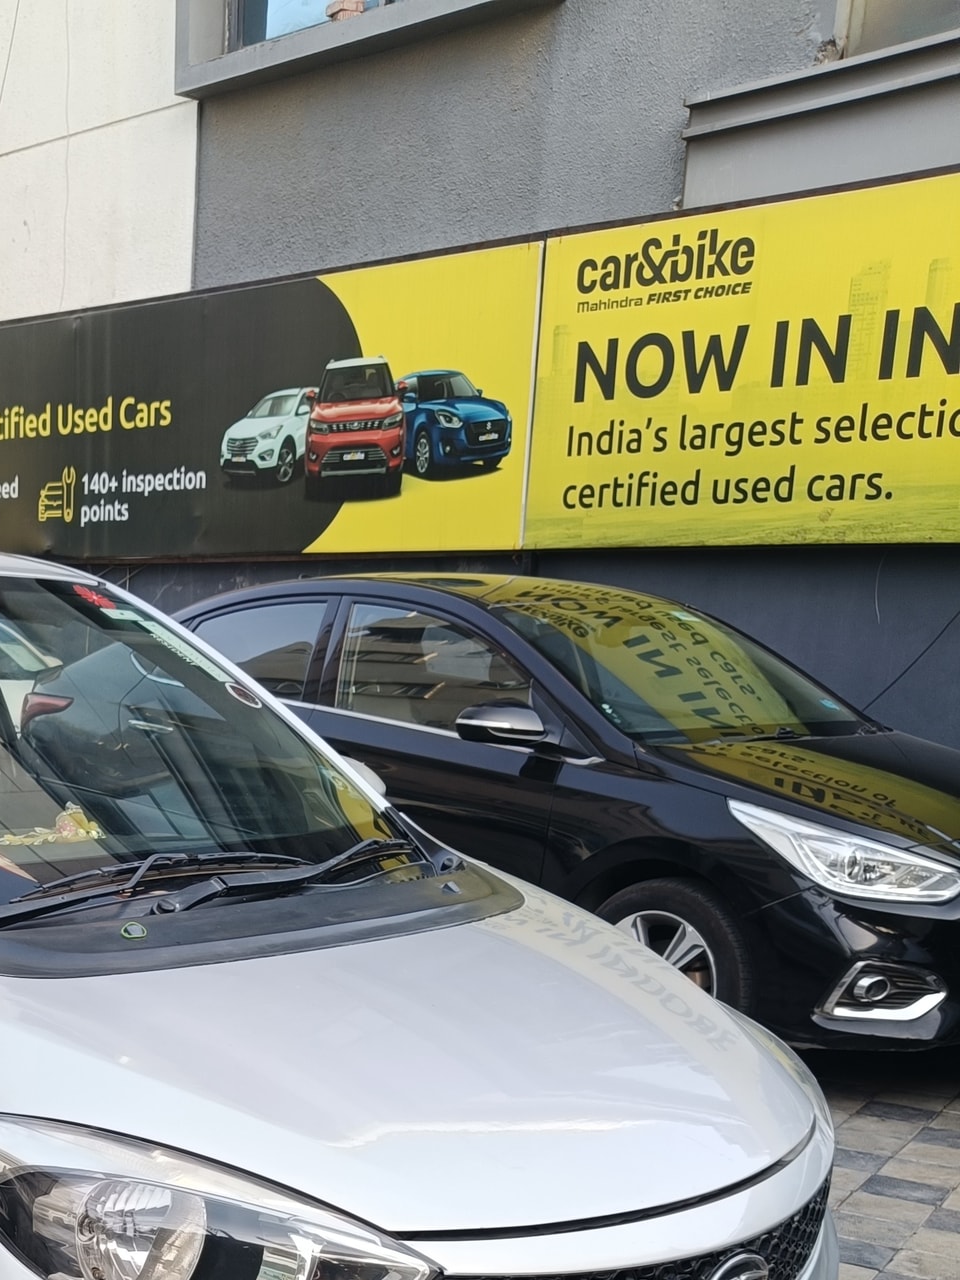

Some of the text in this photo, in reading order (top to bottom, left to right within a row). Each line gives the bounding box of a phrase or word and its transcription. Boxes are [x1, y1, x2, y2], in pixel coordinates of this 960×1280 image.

[576, 228, 755, 295] car&bike
[576, 282, 753, 313] Mahindra FIRST CHOICE
[574, 325, 750, 403] NOW
[770, 314, 852, 388] IN
[57, 395, 112, 435] Used
[119, 396, 172, 431] Cars
[680, 412, 804, 457] largest
[81, 467, 207, 498] 140+ inspection
[563, 465, 893, 509] certified used cars.
[80, 500, 129, 527] points
